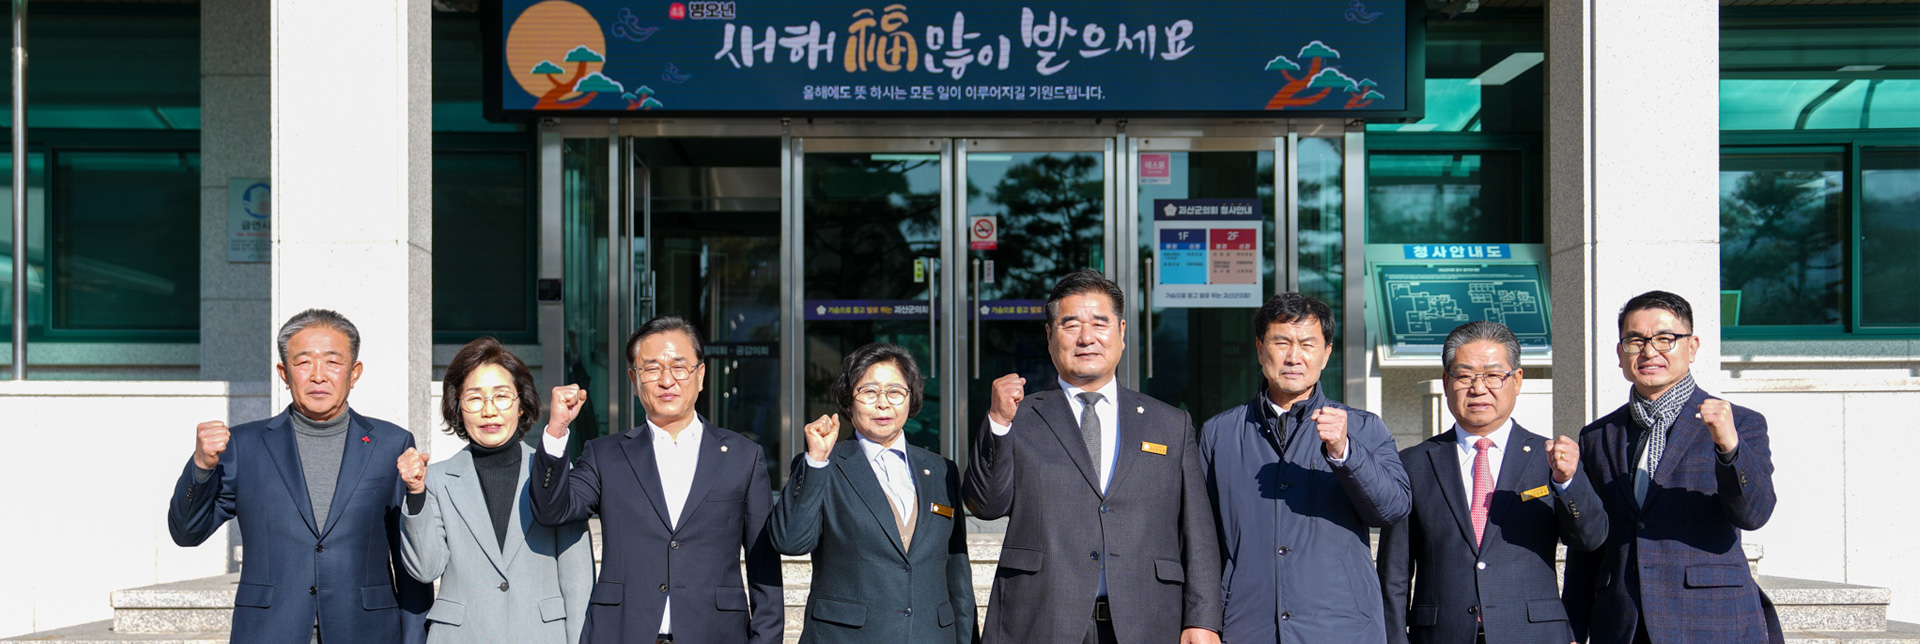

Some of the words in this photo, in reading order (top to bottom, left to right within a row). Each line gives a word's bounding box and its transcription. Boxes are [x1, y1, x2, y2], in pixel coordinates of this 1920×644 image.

[688, 1, 736, 20] 병오년
[714, 20, 837, 71] 새해
[843, 4, 919, 73] 福
[923, 11, 1010, 80] 많이
[1021, 7, 1195, 76] 받으세요
[802, 85, 851, 101] 올해에도
[854, 85, 868, 101] 뜻
[869, 85, 907, 101] 하시는
[910, 85, 934, 101] 모든
[937, 85, 962, 101] 일이
[965, 85, 1025, 101] 이루어지길
[1029, 85, 1106, 101] 기원드립니다.
[1178, 205, 1219, 215] 괴산군의회
[1220, 205, 1253, 215] 청사안내
[1178, 232, 1189, 241] 1F
[1227, 232, 1239, 241] 2F
[1413, 246, 1502, 258] 청사안내도
[828, 305, 852, 315] 가슴으로
